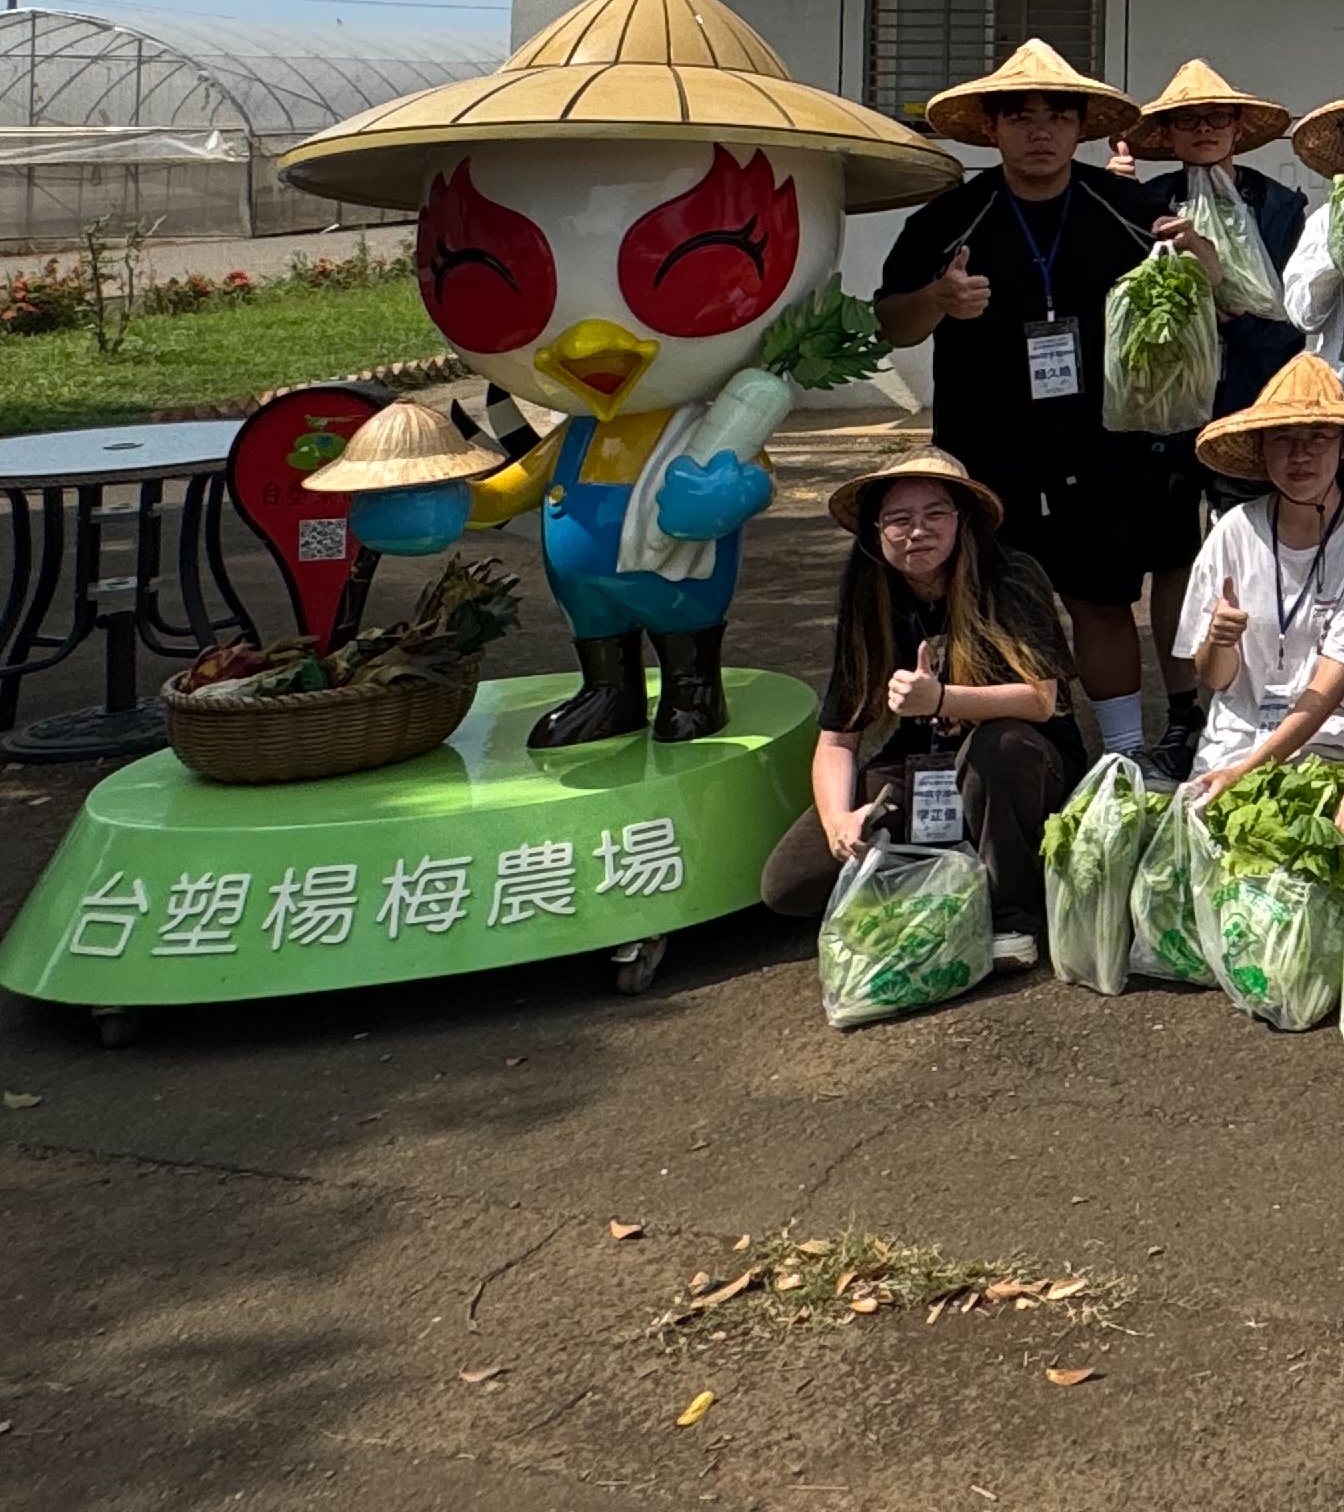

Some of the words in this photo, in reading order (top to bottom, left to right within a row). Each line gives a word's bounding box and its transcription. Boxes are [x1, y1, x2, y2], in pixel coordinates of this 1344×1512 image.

[68, 816, 686, 959] 台塑楊梅農場
